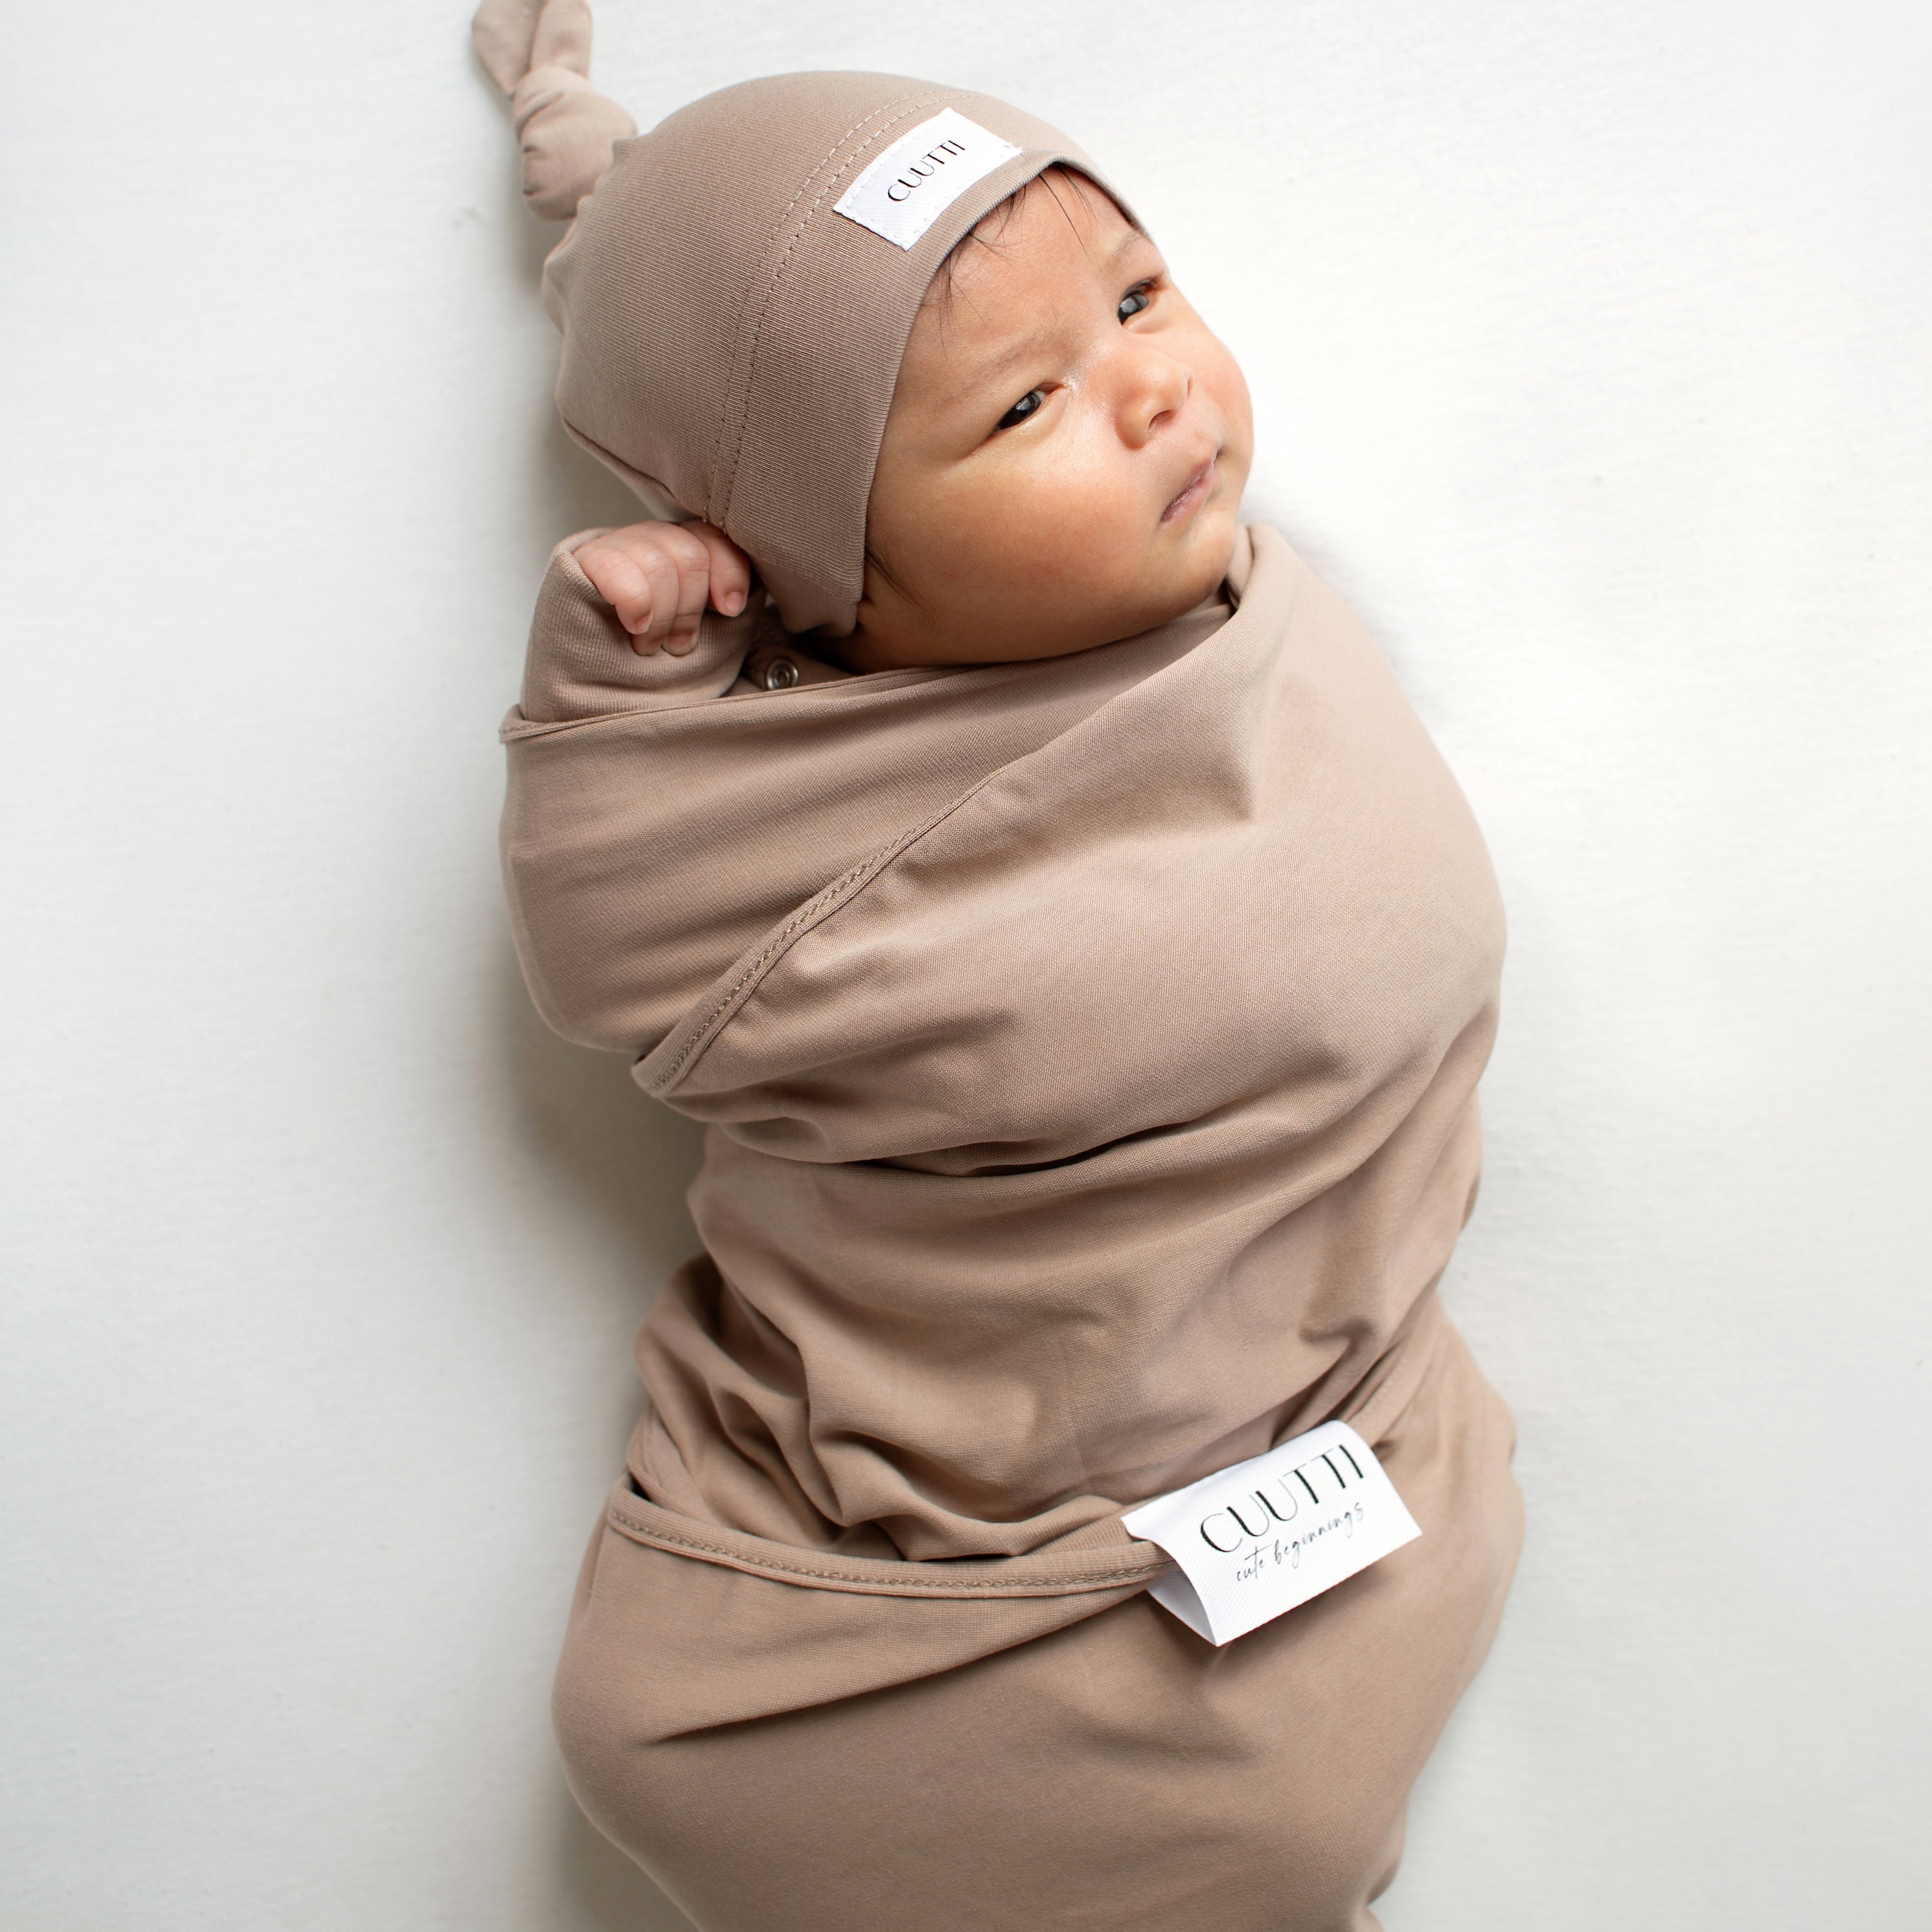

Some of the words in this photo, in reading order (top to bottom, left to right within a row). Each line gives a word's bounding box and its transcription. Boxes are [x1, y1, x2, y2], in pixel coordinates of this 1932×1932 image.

[887, 140, 966, 201] CUUTTI
[1200, 1444, 1364, 1552] CUUTTI
[1236, 1546, 1270, 1582] cute
[1274, 1501, 1364, 1569] beginnings
